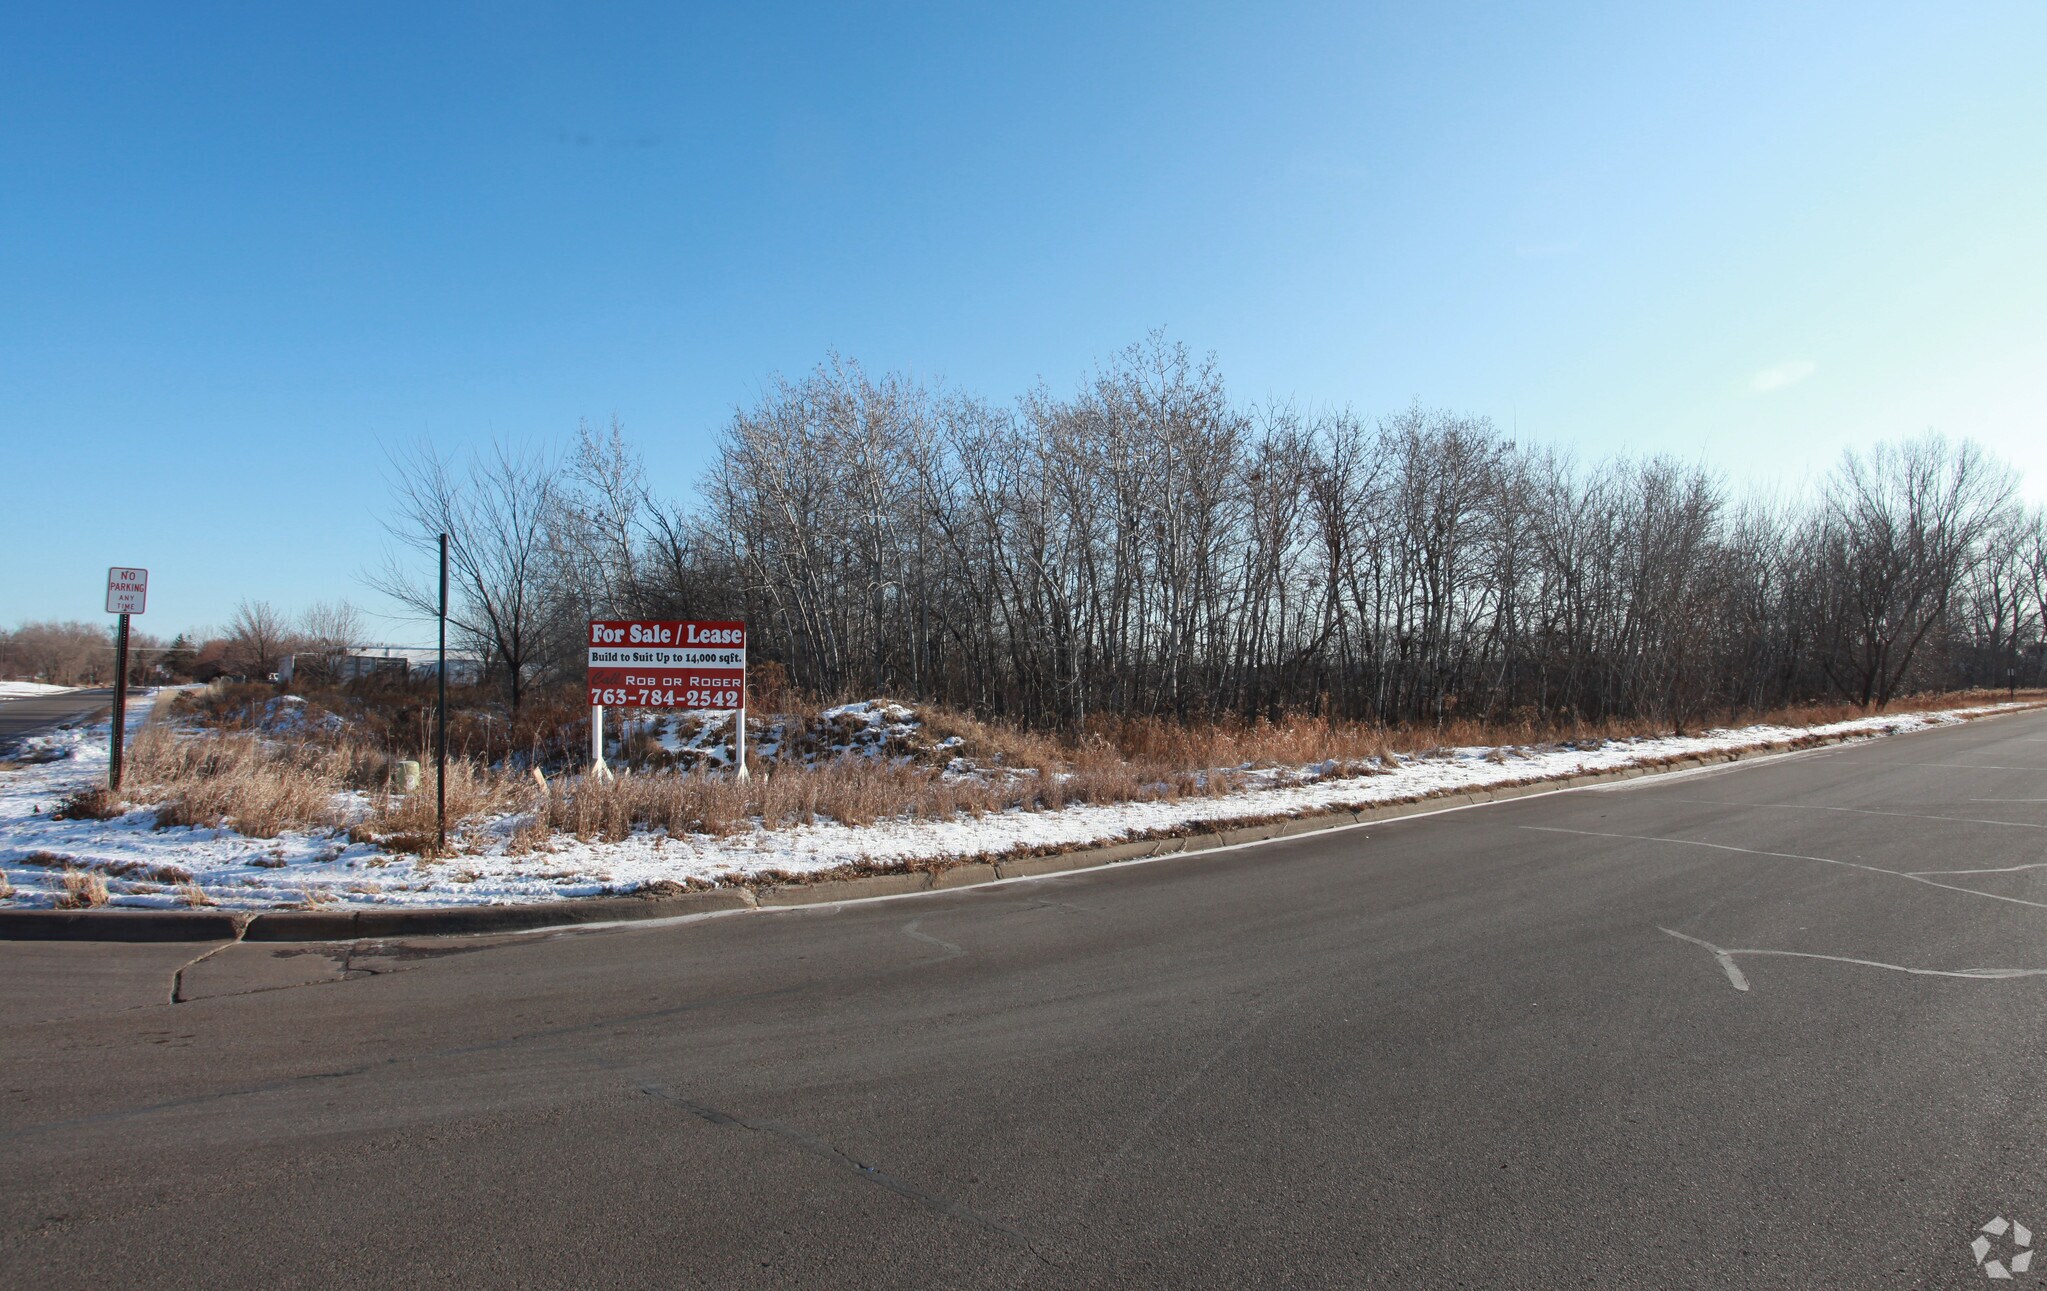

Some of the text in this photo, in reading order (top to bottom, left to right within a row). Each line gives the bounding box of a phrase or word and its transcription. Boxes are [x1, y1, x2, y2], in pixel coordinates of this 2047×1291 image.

[121, 572, 136, 580] NO
[110, 582, 144, 592] PARKING
[592, 624, 625, 643] For
[629, 624, 671, 643] Sale
[687, 624, 742, 644] Lease
[592, 652, 742, 664] Build to Suit Up to 14,000 sqft.
[591, 688, 738, 707] 763-784-2542
